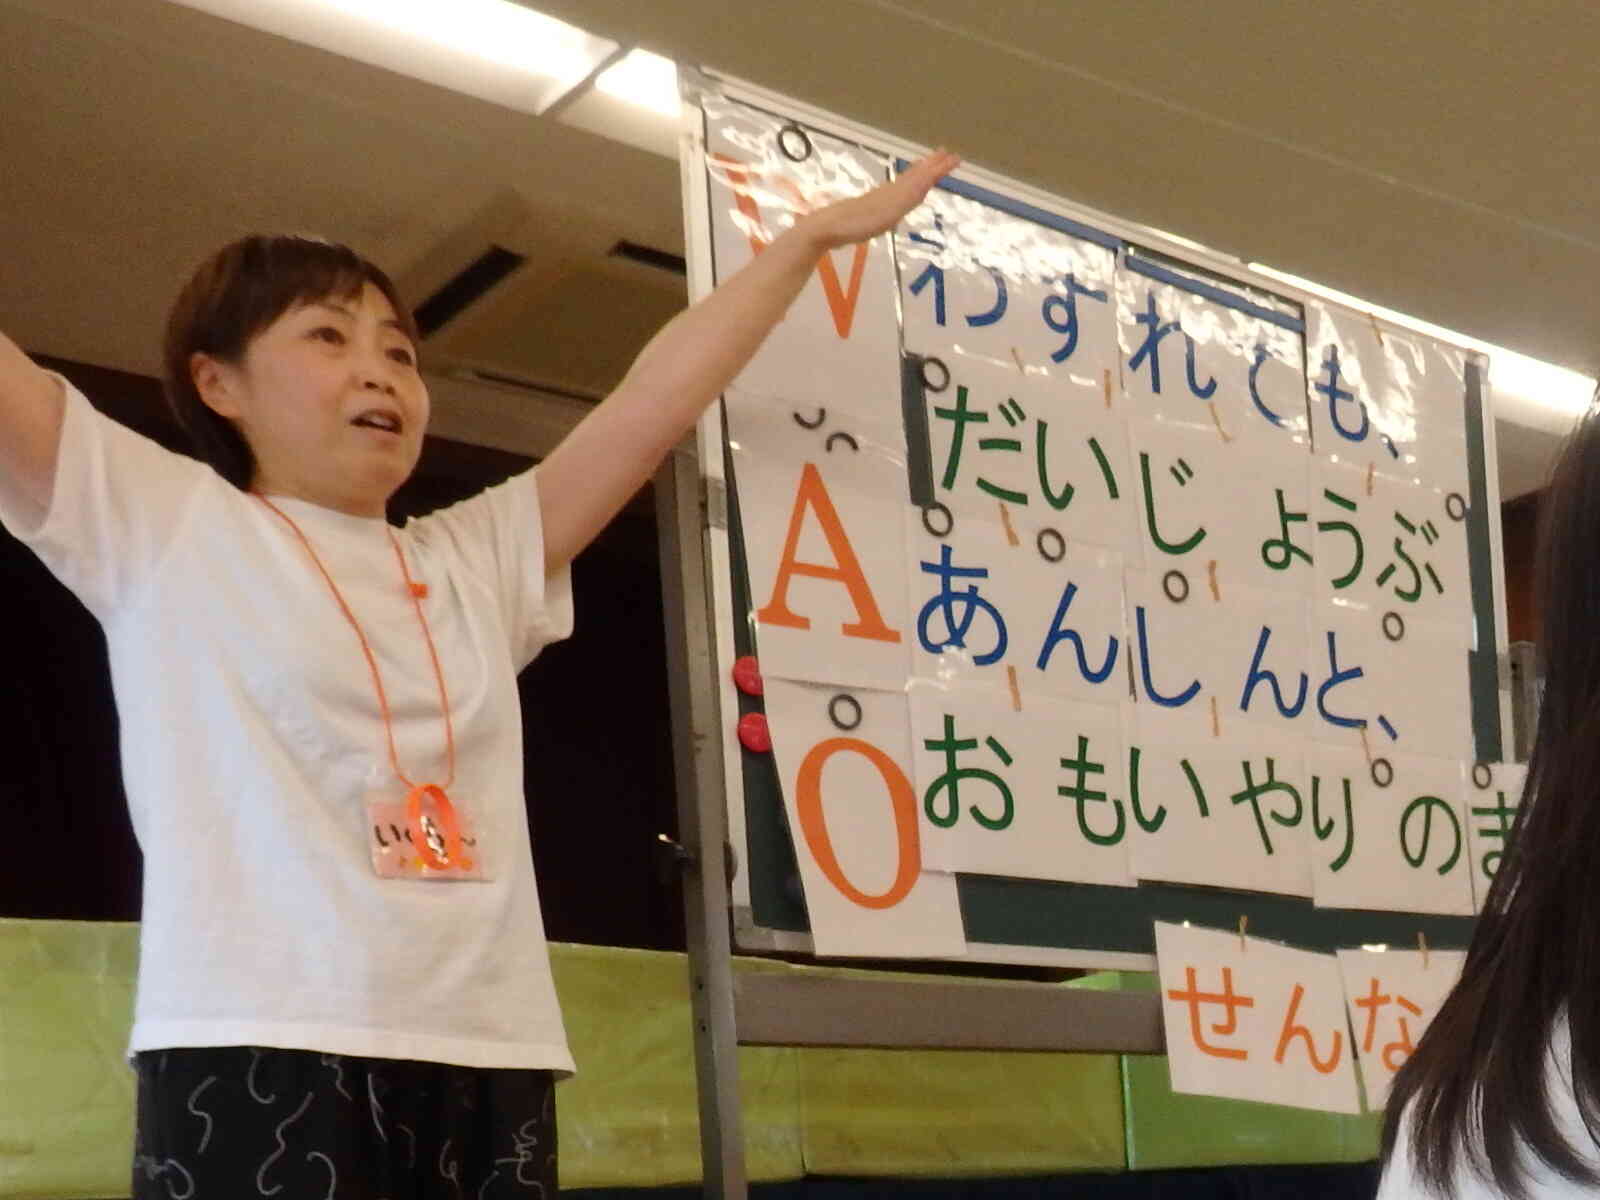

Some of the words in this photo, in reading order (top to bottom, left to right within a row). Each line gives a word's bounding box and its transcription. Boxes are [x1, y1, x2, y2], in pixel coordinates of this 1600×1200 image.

[917, 544, 1398, 741] あんしんと、
